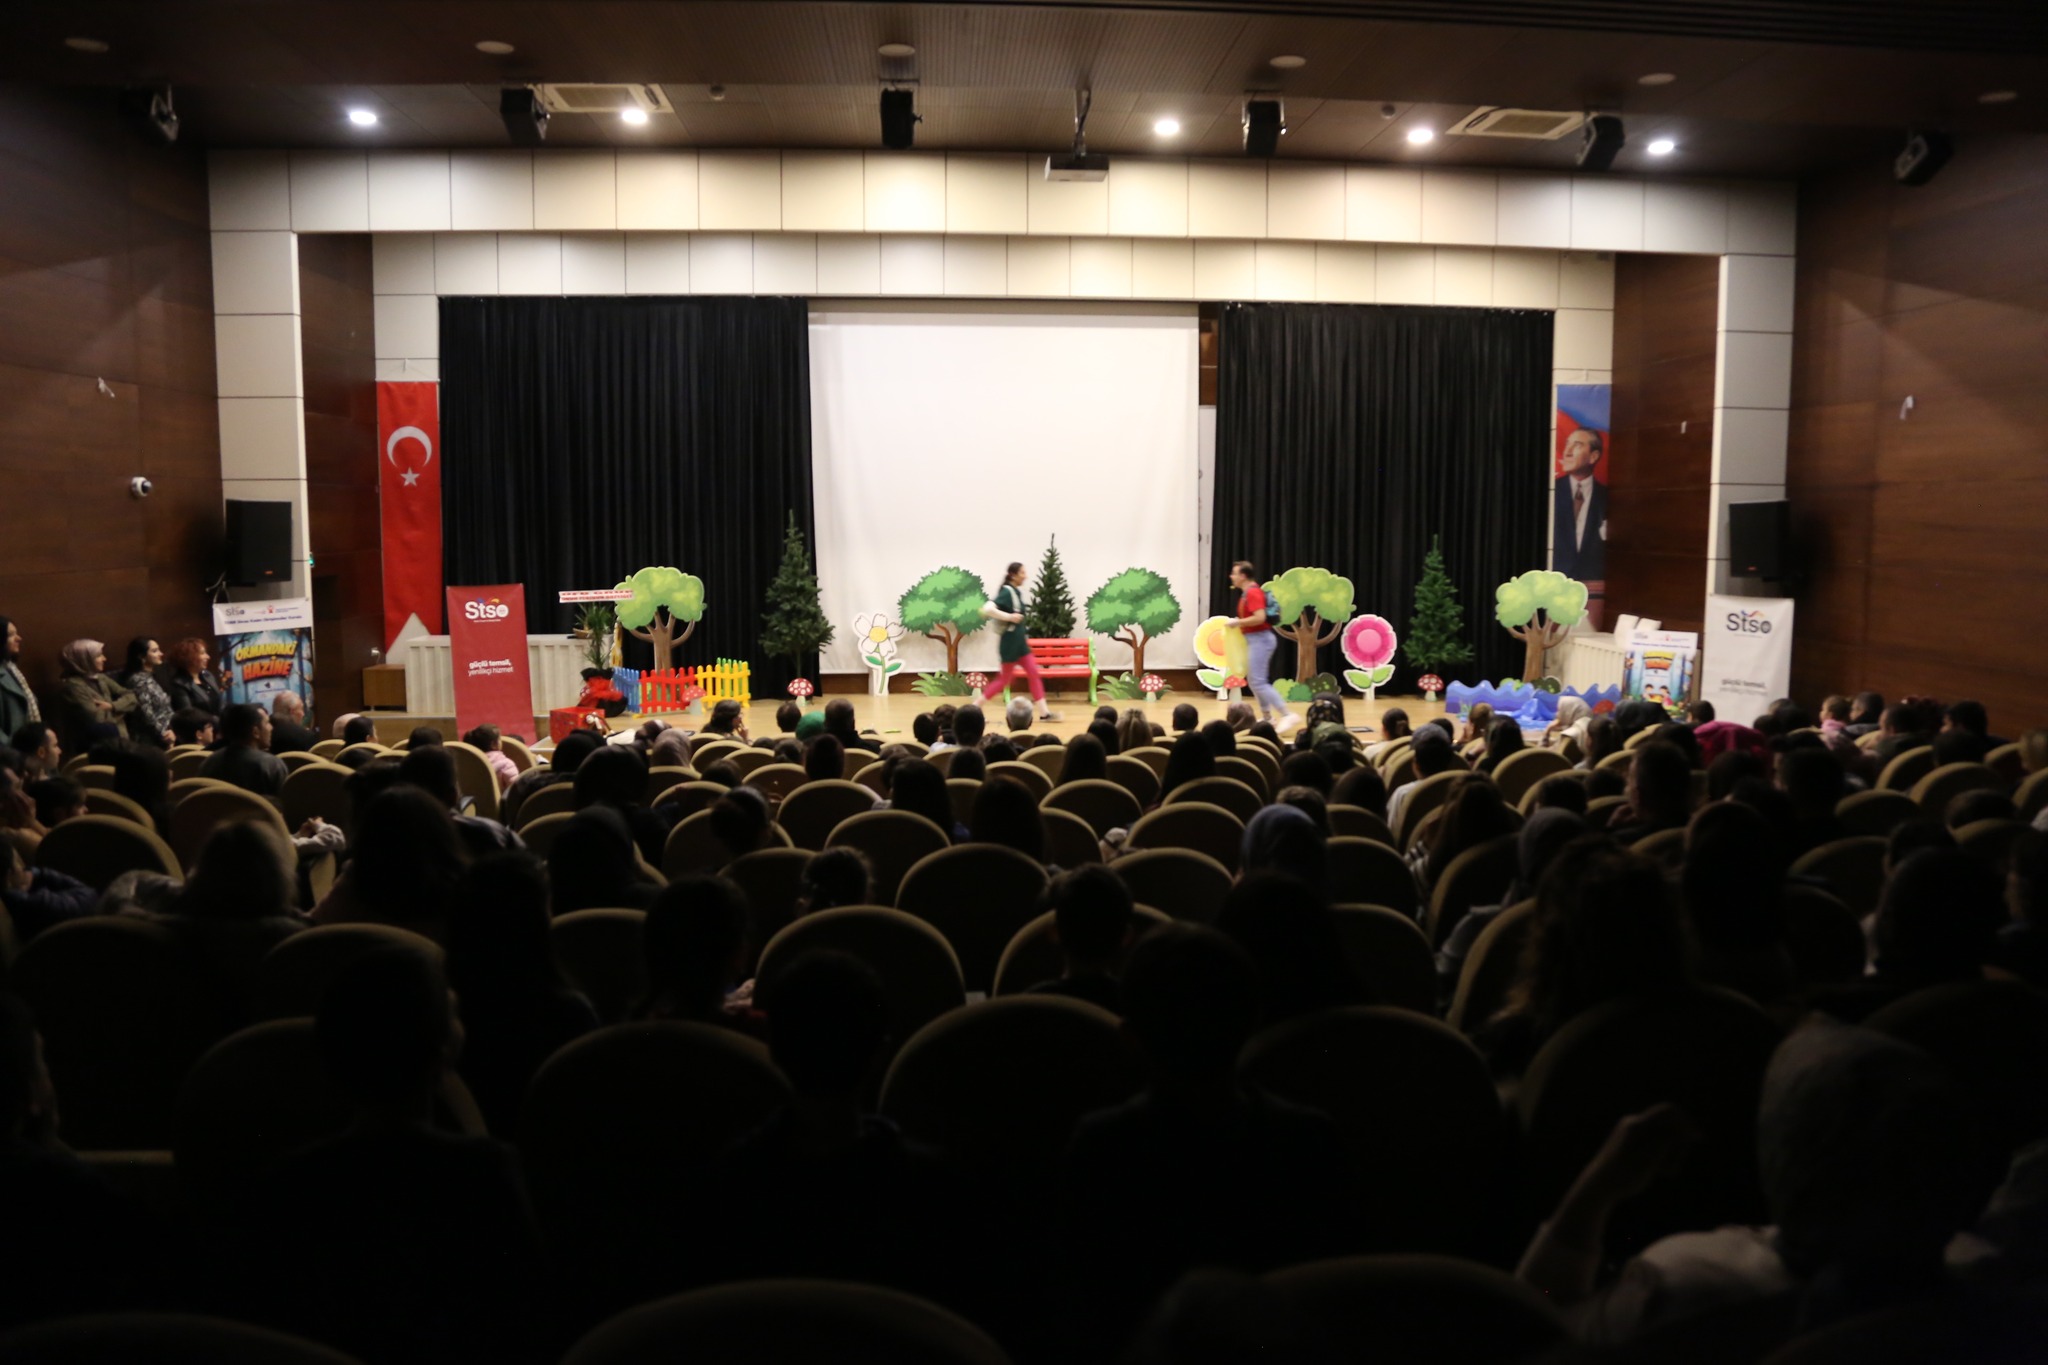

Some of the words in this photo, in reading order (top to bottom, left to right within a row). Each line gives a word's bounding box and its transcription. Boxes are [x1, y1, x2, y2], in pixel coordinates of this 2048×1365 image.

[465, 601, 509, 619] Stso
[1726, 613, 1772, 634] Stso
[243, 655, 293, 681] HAZİNE
